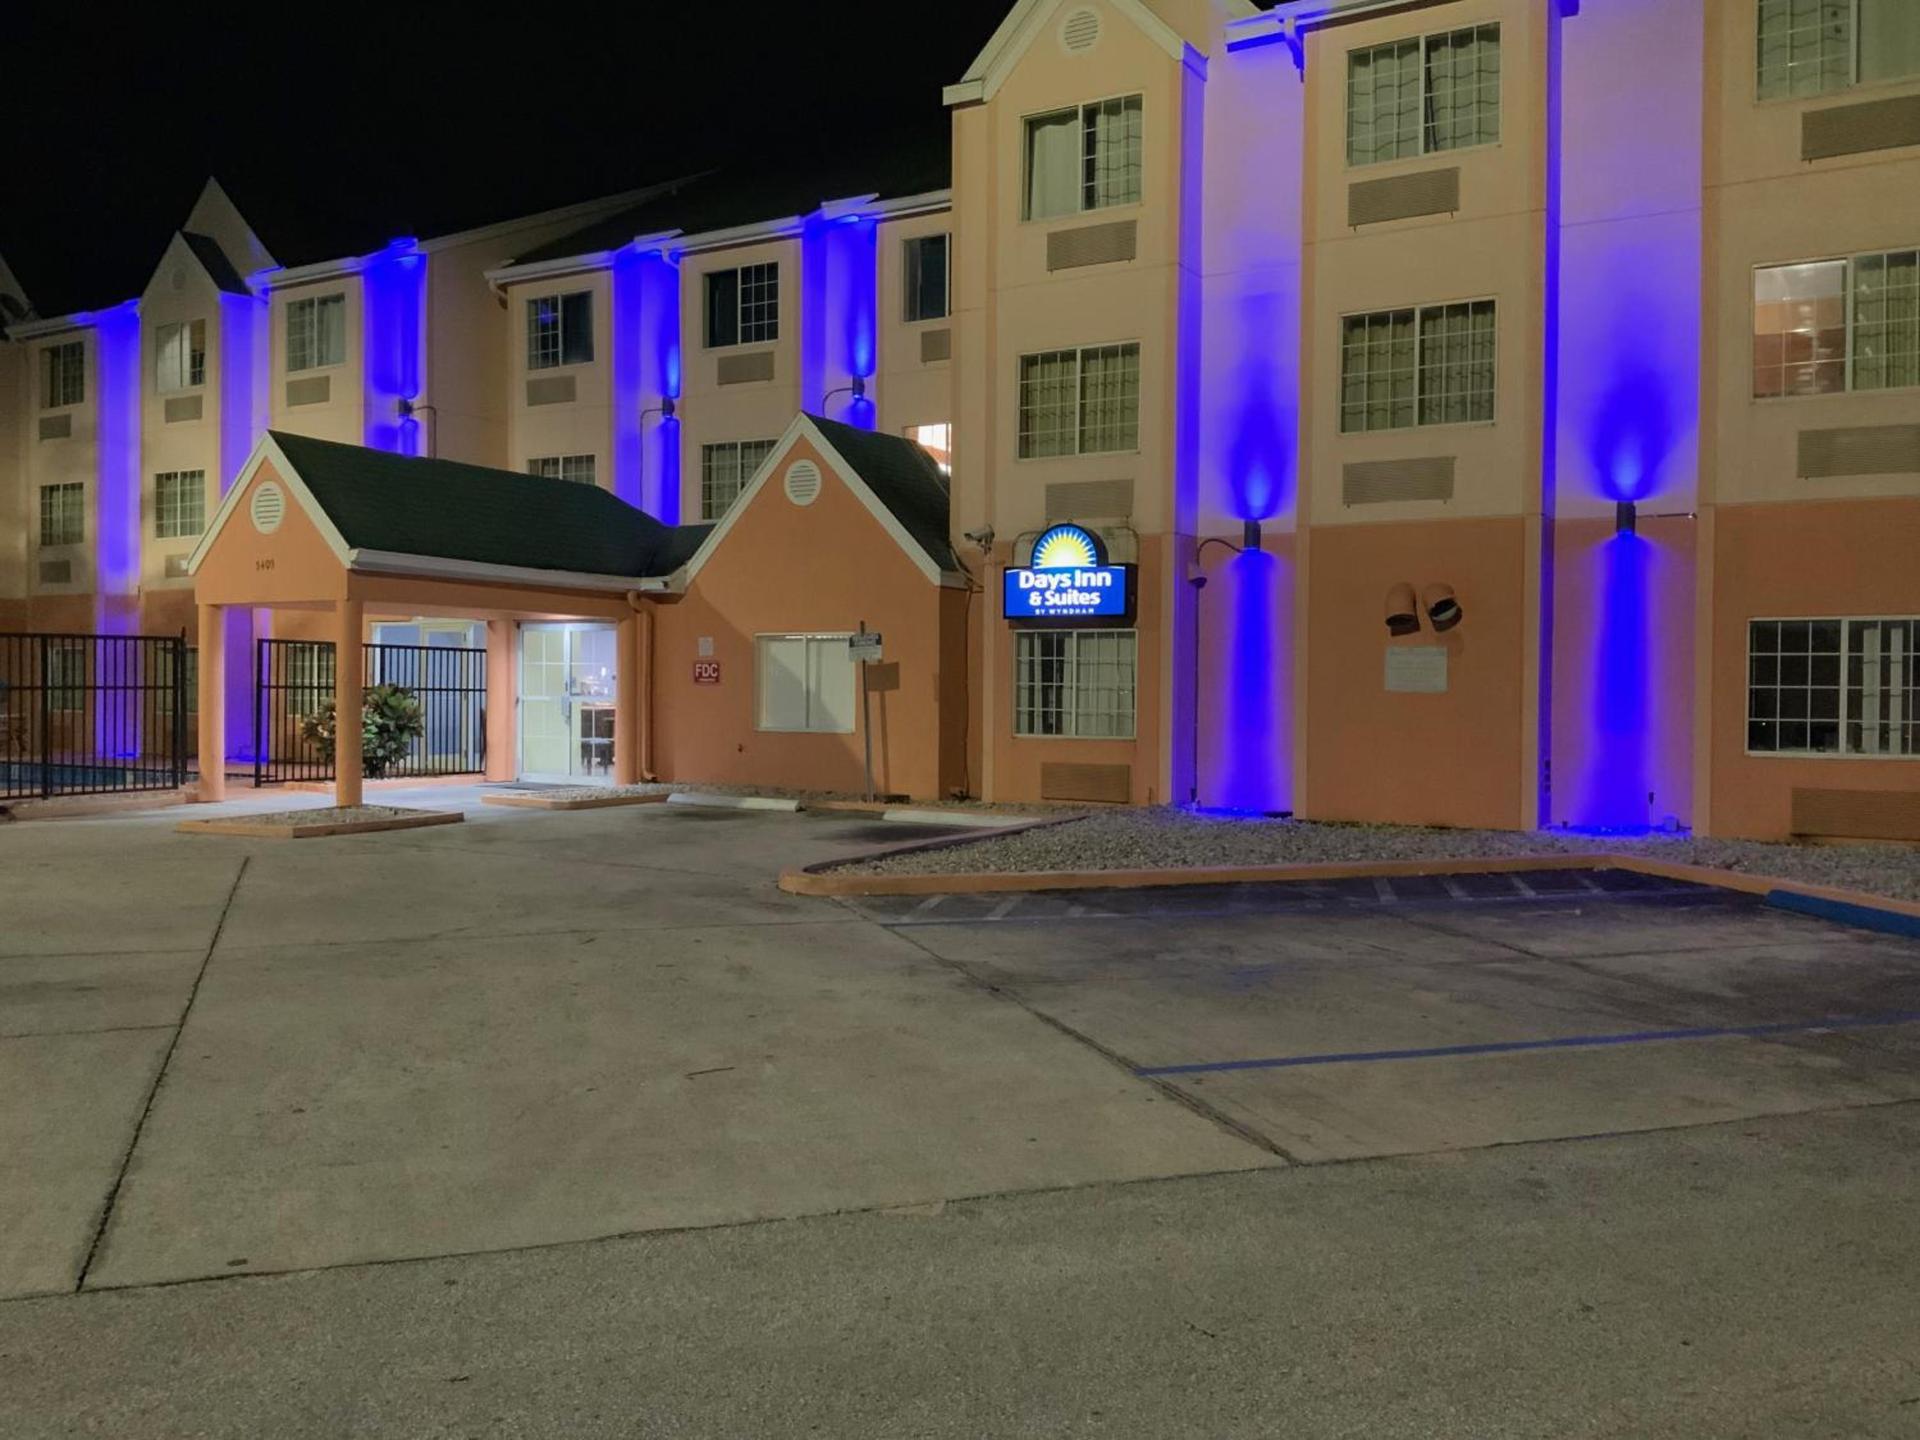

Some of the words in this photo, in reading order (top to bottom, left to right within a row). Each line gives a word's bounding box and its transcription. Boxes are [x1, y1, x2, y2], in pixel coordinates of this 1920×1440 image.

[1019, 571, 1072, 590] Days
[1074, 569, 1112, 587] Inn
[1029, 591, 1042, 606] &
[1044, 589, 1101, 606] Suites
[695, 663, 718, 677] FDC
